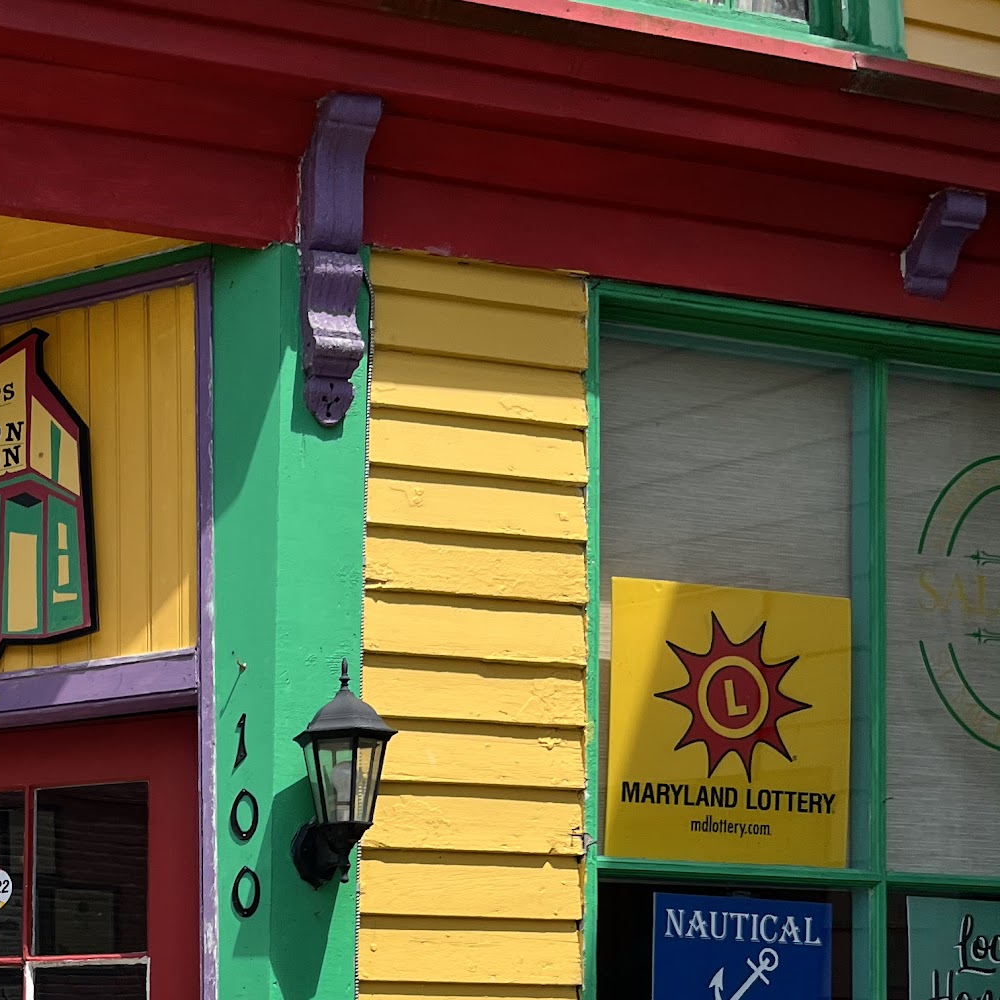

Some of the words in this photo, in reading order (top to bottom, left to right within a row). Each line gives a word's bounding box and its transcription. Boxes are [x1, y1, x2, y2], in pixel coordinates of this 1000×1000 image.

[724, 679, 748, 717] L
[621, 781, 738, 808] MARYLAND
[746, 787, 836, 815] LOTTERY
[690, 815, 771, 838] mdlottery.com
[664, 908, 824, 945] NAUTICAL
